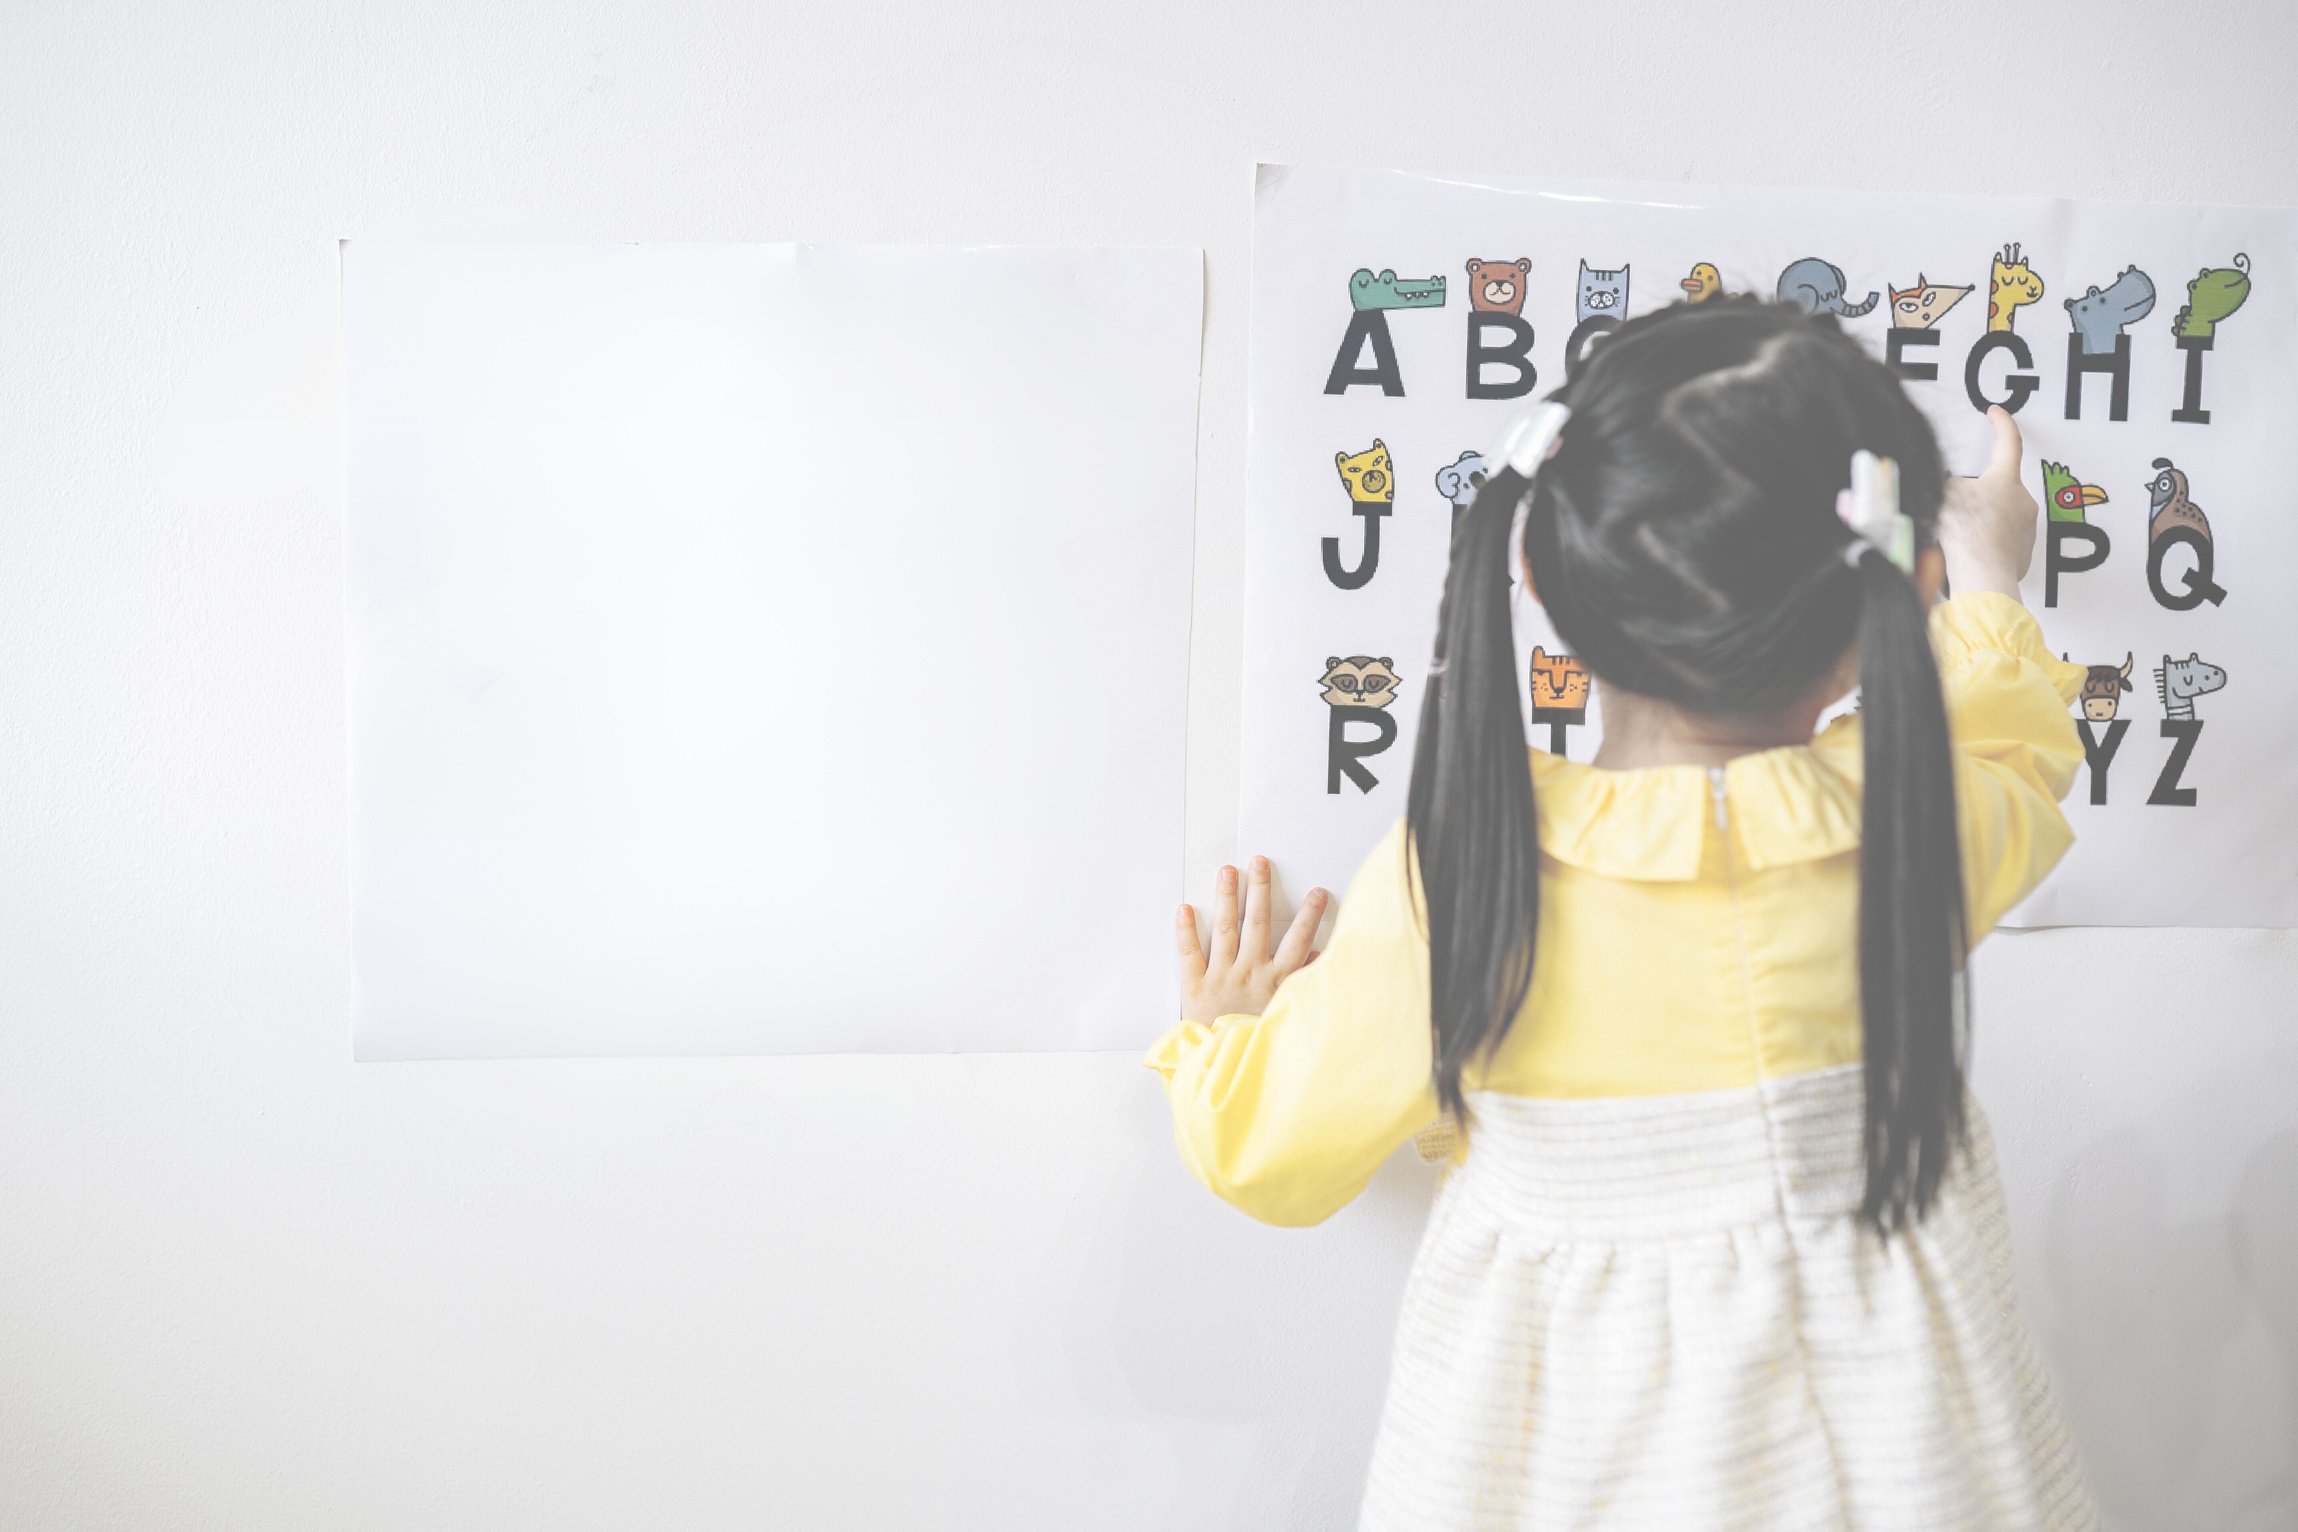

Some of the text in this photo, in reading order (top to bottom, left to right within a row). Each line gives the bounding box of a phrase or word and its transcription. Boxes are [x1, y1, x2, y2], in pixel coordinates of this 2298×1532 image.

[1323, 310, 1405, 397] A
[1466, 311, 1538, 400] B
[1964, 330, 2040, 416] G
[2064, 331, 2131, 422] H
[2171, 336, 2215, 425] I
[1321, 501, 1393, 591] J
[2044, 521, 2111, 608] P
[2146, 525, 2228, 611] Q
[1327, 705, 2205, 807] R T Y Z
